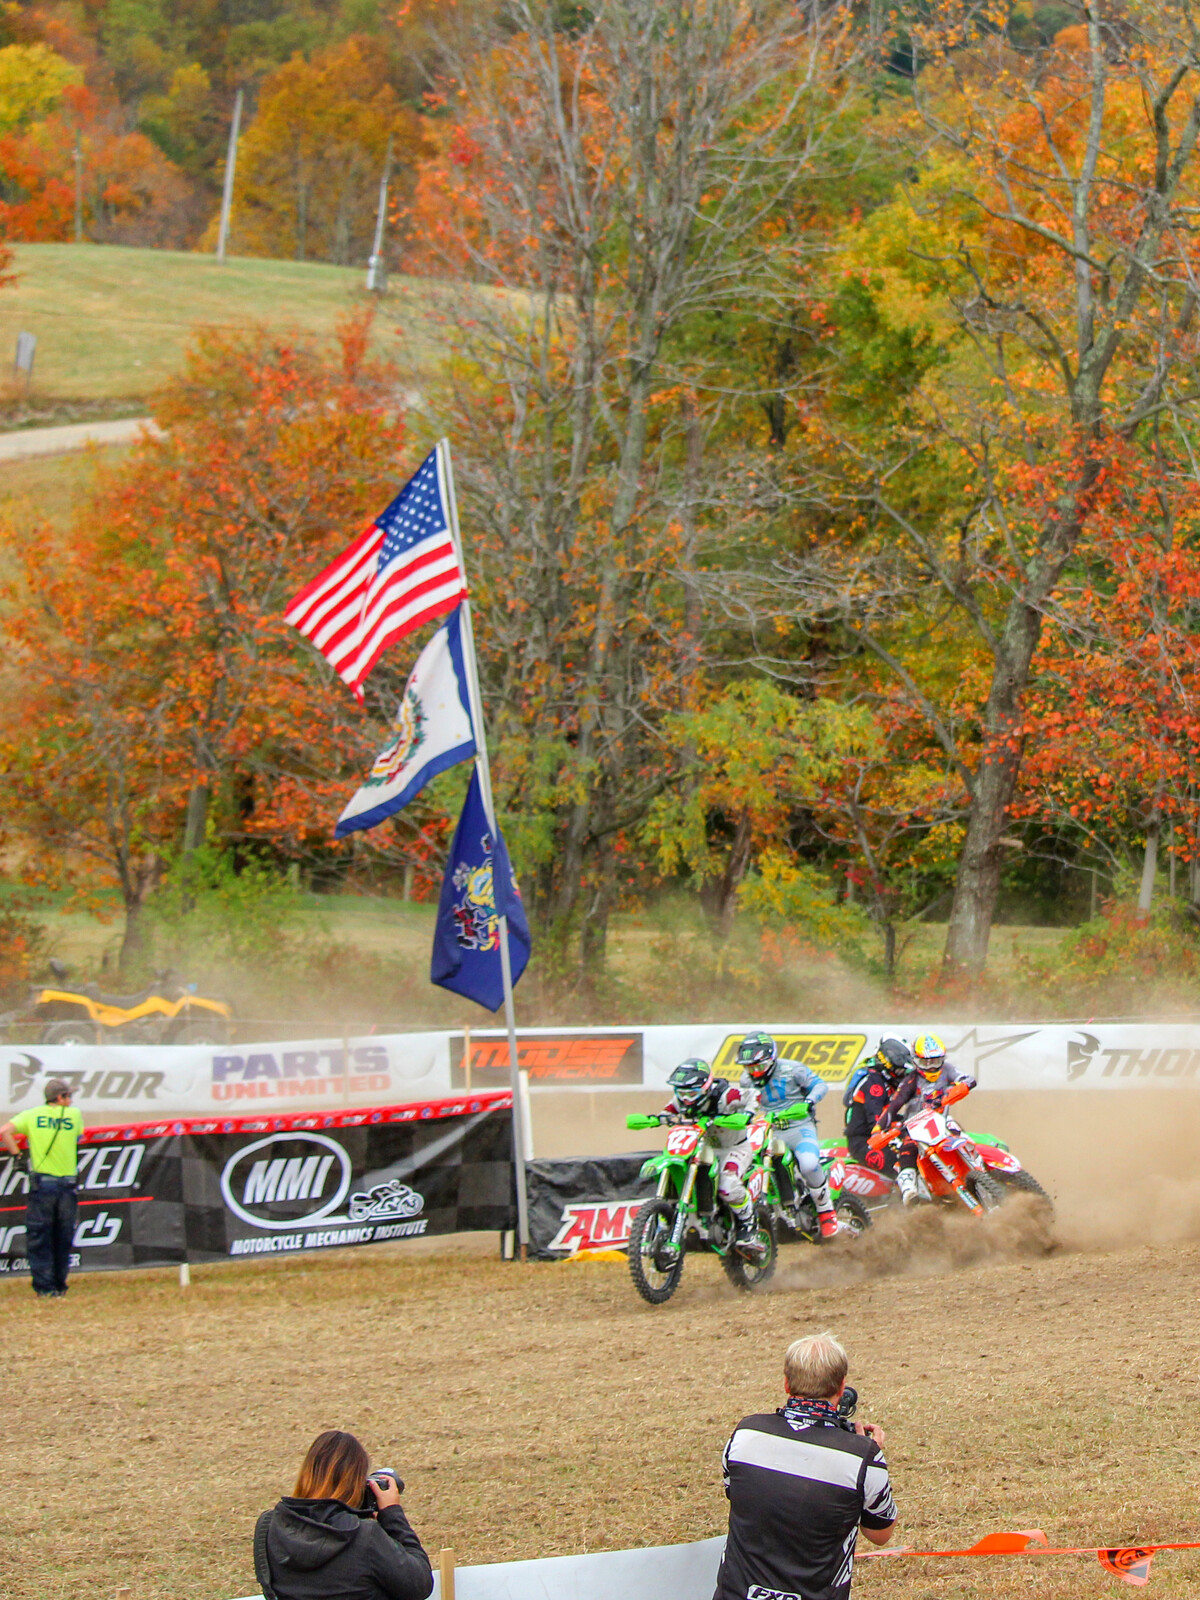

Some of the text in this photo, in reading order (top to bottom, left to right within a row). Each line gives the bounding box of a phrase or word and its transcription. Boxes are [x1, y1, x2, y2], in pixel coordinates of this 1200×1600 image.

[212, 1046, 390, 1082] PARTS
[528, 1065, 619, 1079] RACING
[211, 1074, 391, 1101] UNLIMITED
[36, 1116, 74, 1131] EMS
[924, 1118, 941, 1140] 1
[667, 1130, 700, 1152] 127
[242, 1154, 336, 1205] MMI
[843, 1173, 876, 1196] 410
[230, 1218, 429, 1256] MOTORCYCLE MECHANICS INSTITUTE
